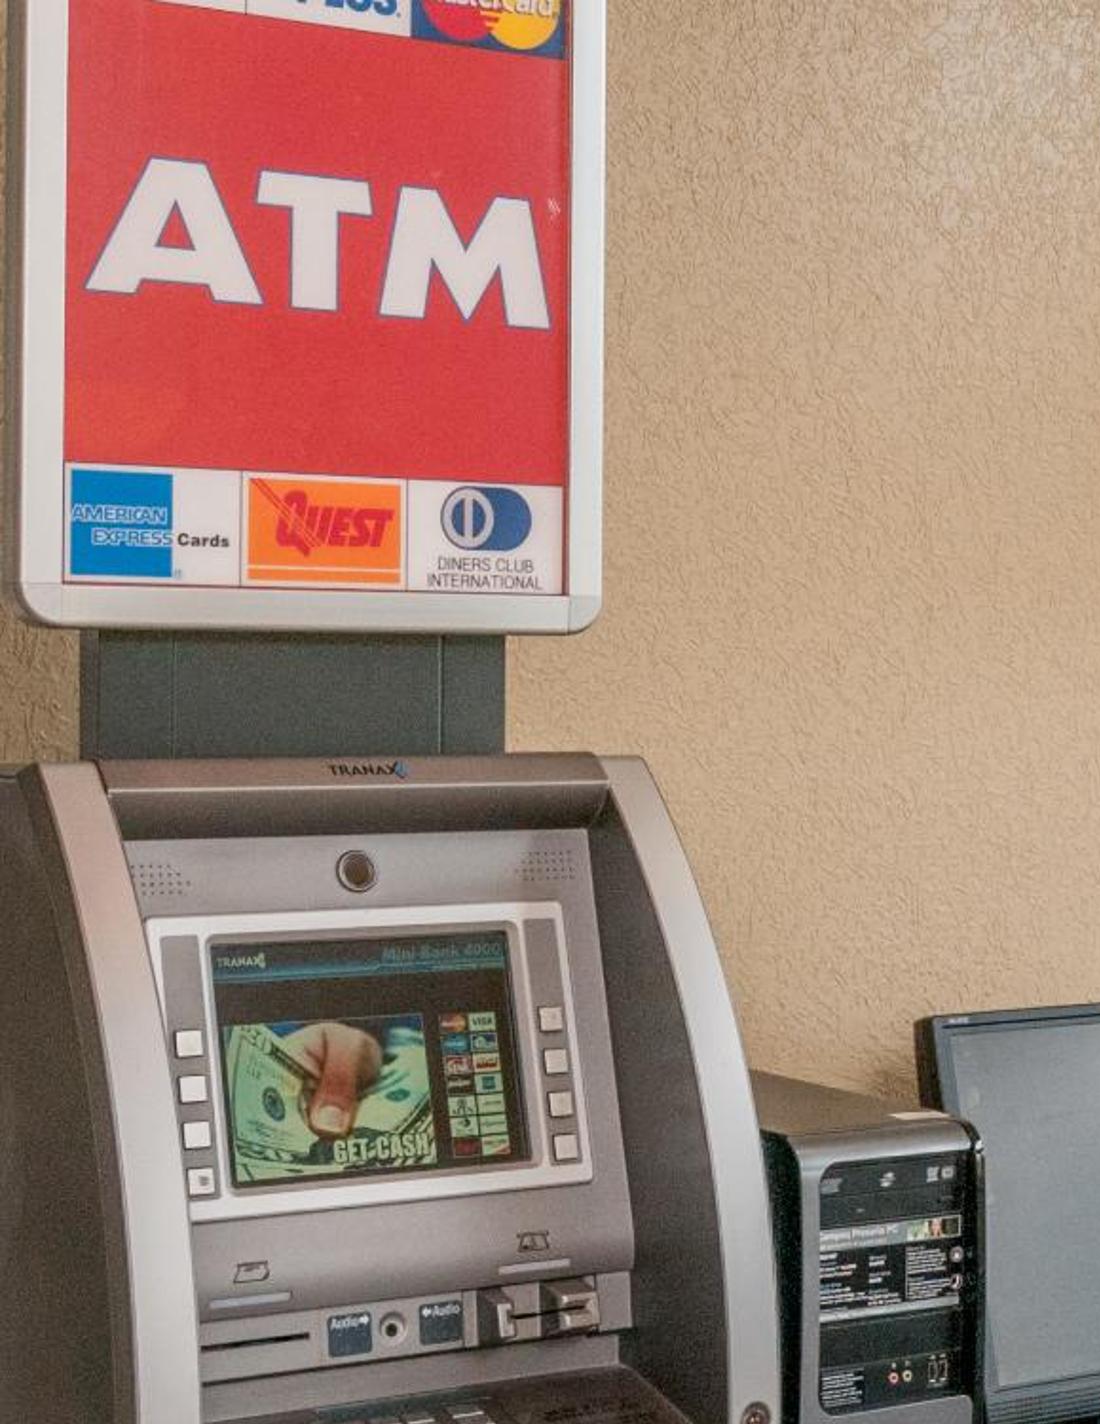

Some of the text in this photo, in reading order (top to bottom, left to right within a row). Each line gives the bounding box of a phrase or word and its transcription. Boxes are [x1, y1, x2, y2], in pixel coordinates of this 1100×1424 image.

[85, 155, 552, 331] ATM
[72, 503, 168, 525] AMERICAN
[91, 527, 230, 548] EXPRESS Cards
[438, 556, 535, 574] DINERS CLUB
[427, 573, 543, 590] INTERNATIONAL
[329, 761, 406, 779] TRANAX
